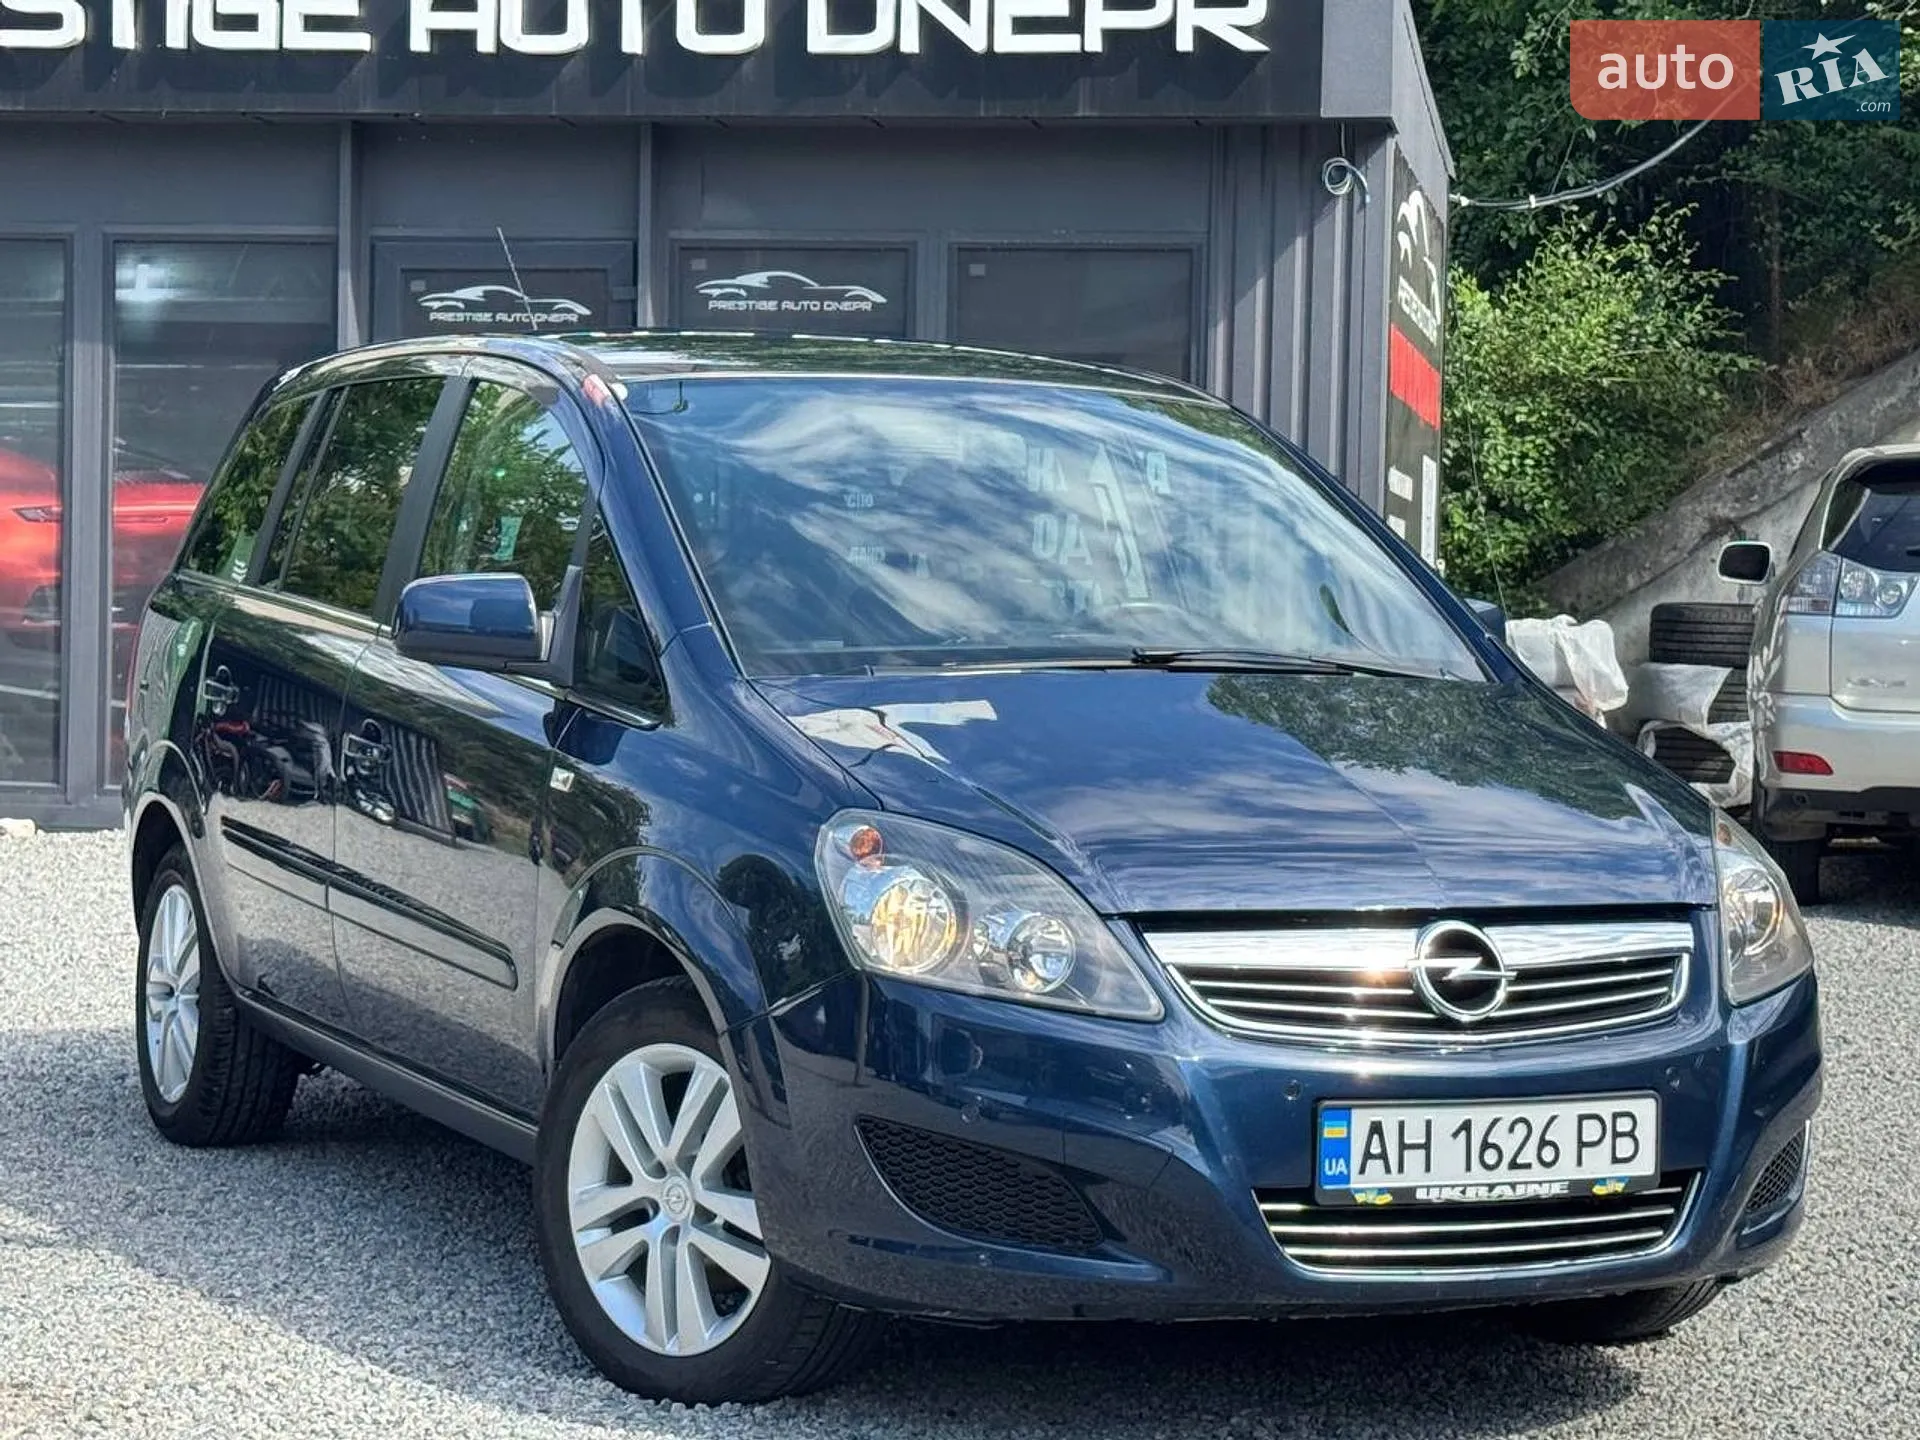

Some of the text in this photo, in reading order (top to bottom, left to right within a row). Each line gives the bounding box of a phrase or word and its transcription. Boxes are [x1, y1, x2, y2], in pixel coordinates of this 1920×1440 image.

[806, 0, 1270, 53] DNEPR
[708, 300, 872, 312] PRESTIGE AUTO DNEPR
[429, 312, 493, 322] PRESTIGE
[1358, 1111, 1640, 1175] AH 1626 PB
[1324, 1159, 1348, 1176] UA
[1415, 1181, 1569, 1201] UKRAINE
